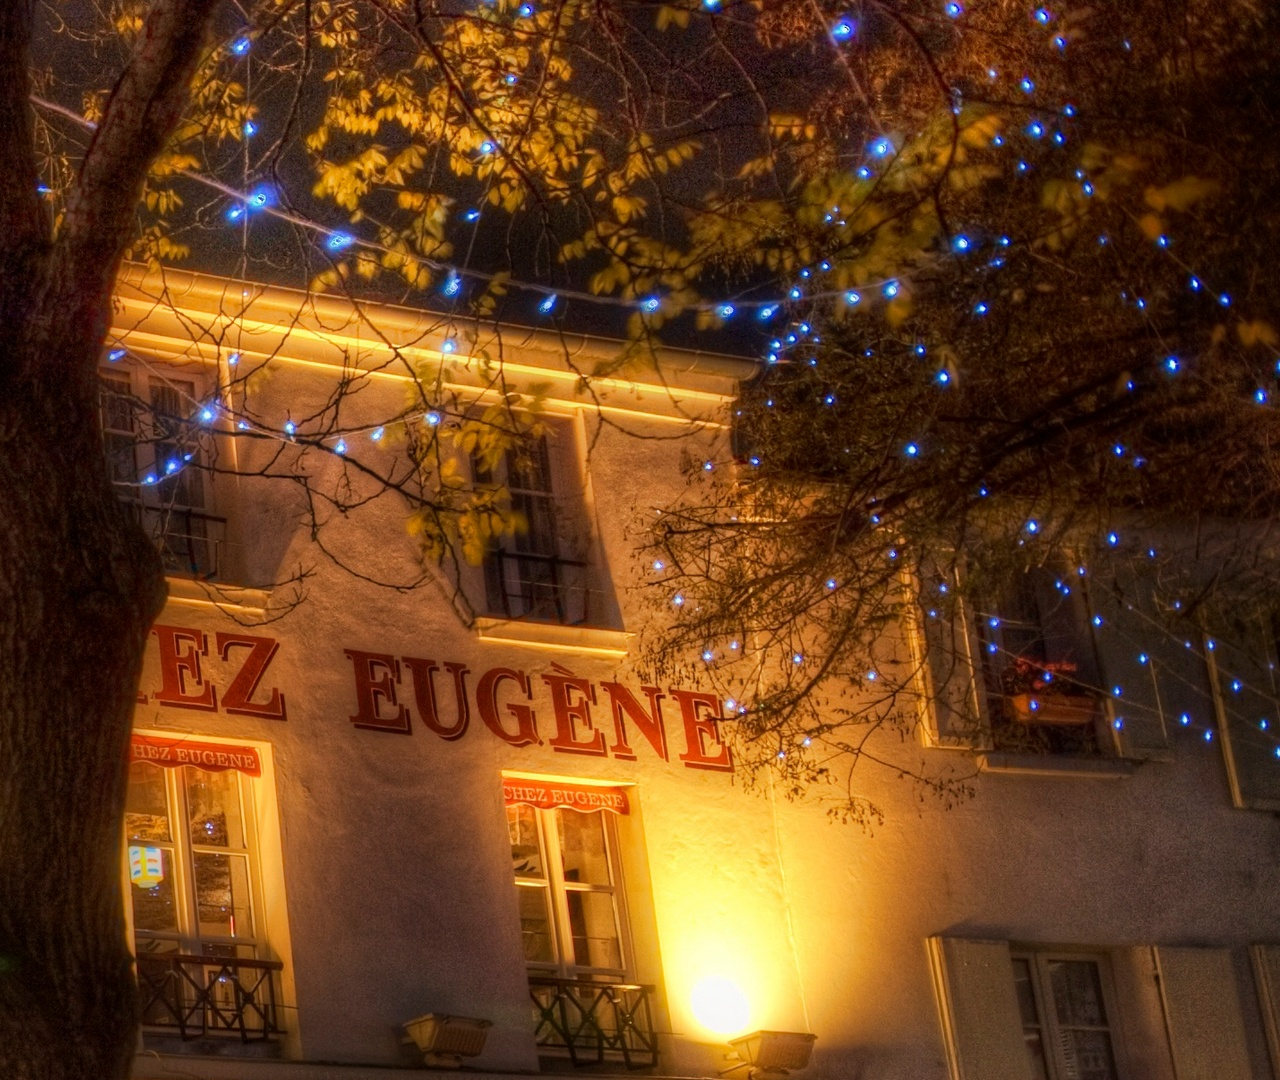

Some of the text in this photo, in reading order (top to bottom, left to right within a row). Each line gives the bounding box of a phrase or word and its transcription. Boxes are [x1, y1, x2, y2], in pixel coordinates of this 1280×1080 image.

[344, 649, 734, 773] EUGÈNE
[131, 743, 255, 769] HEZ EUGENE
[503, 785, 624, 807] CHEZ EUGENE
